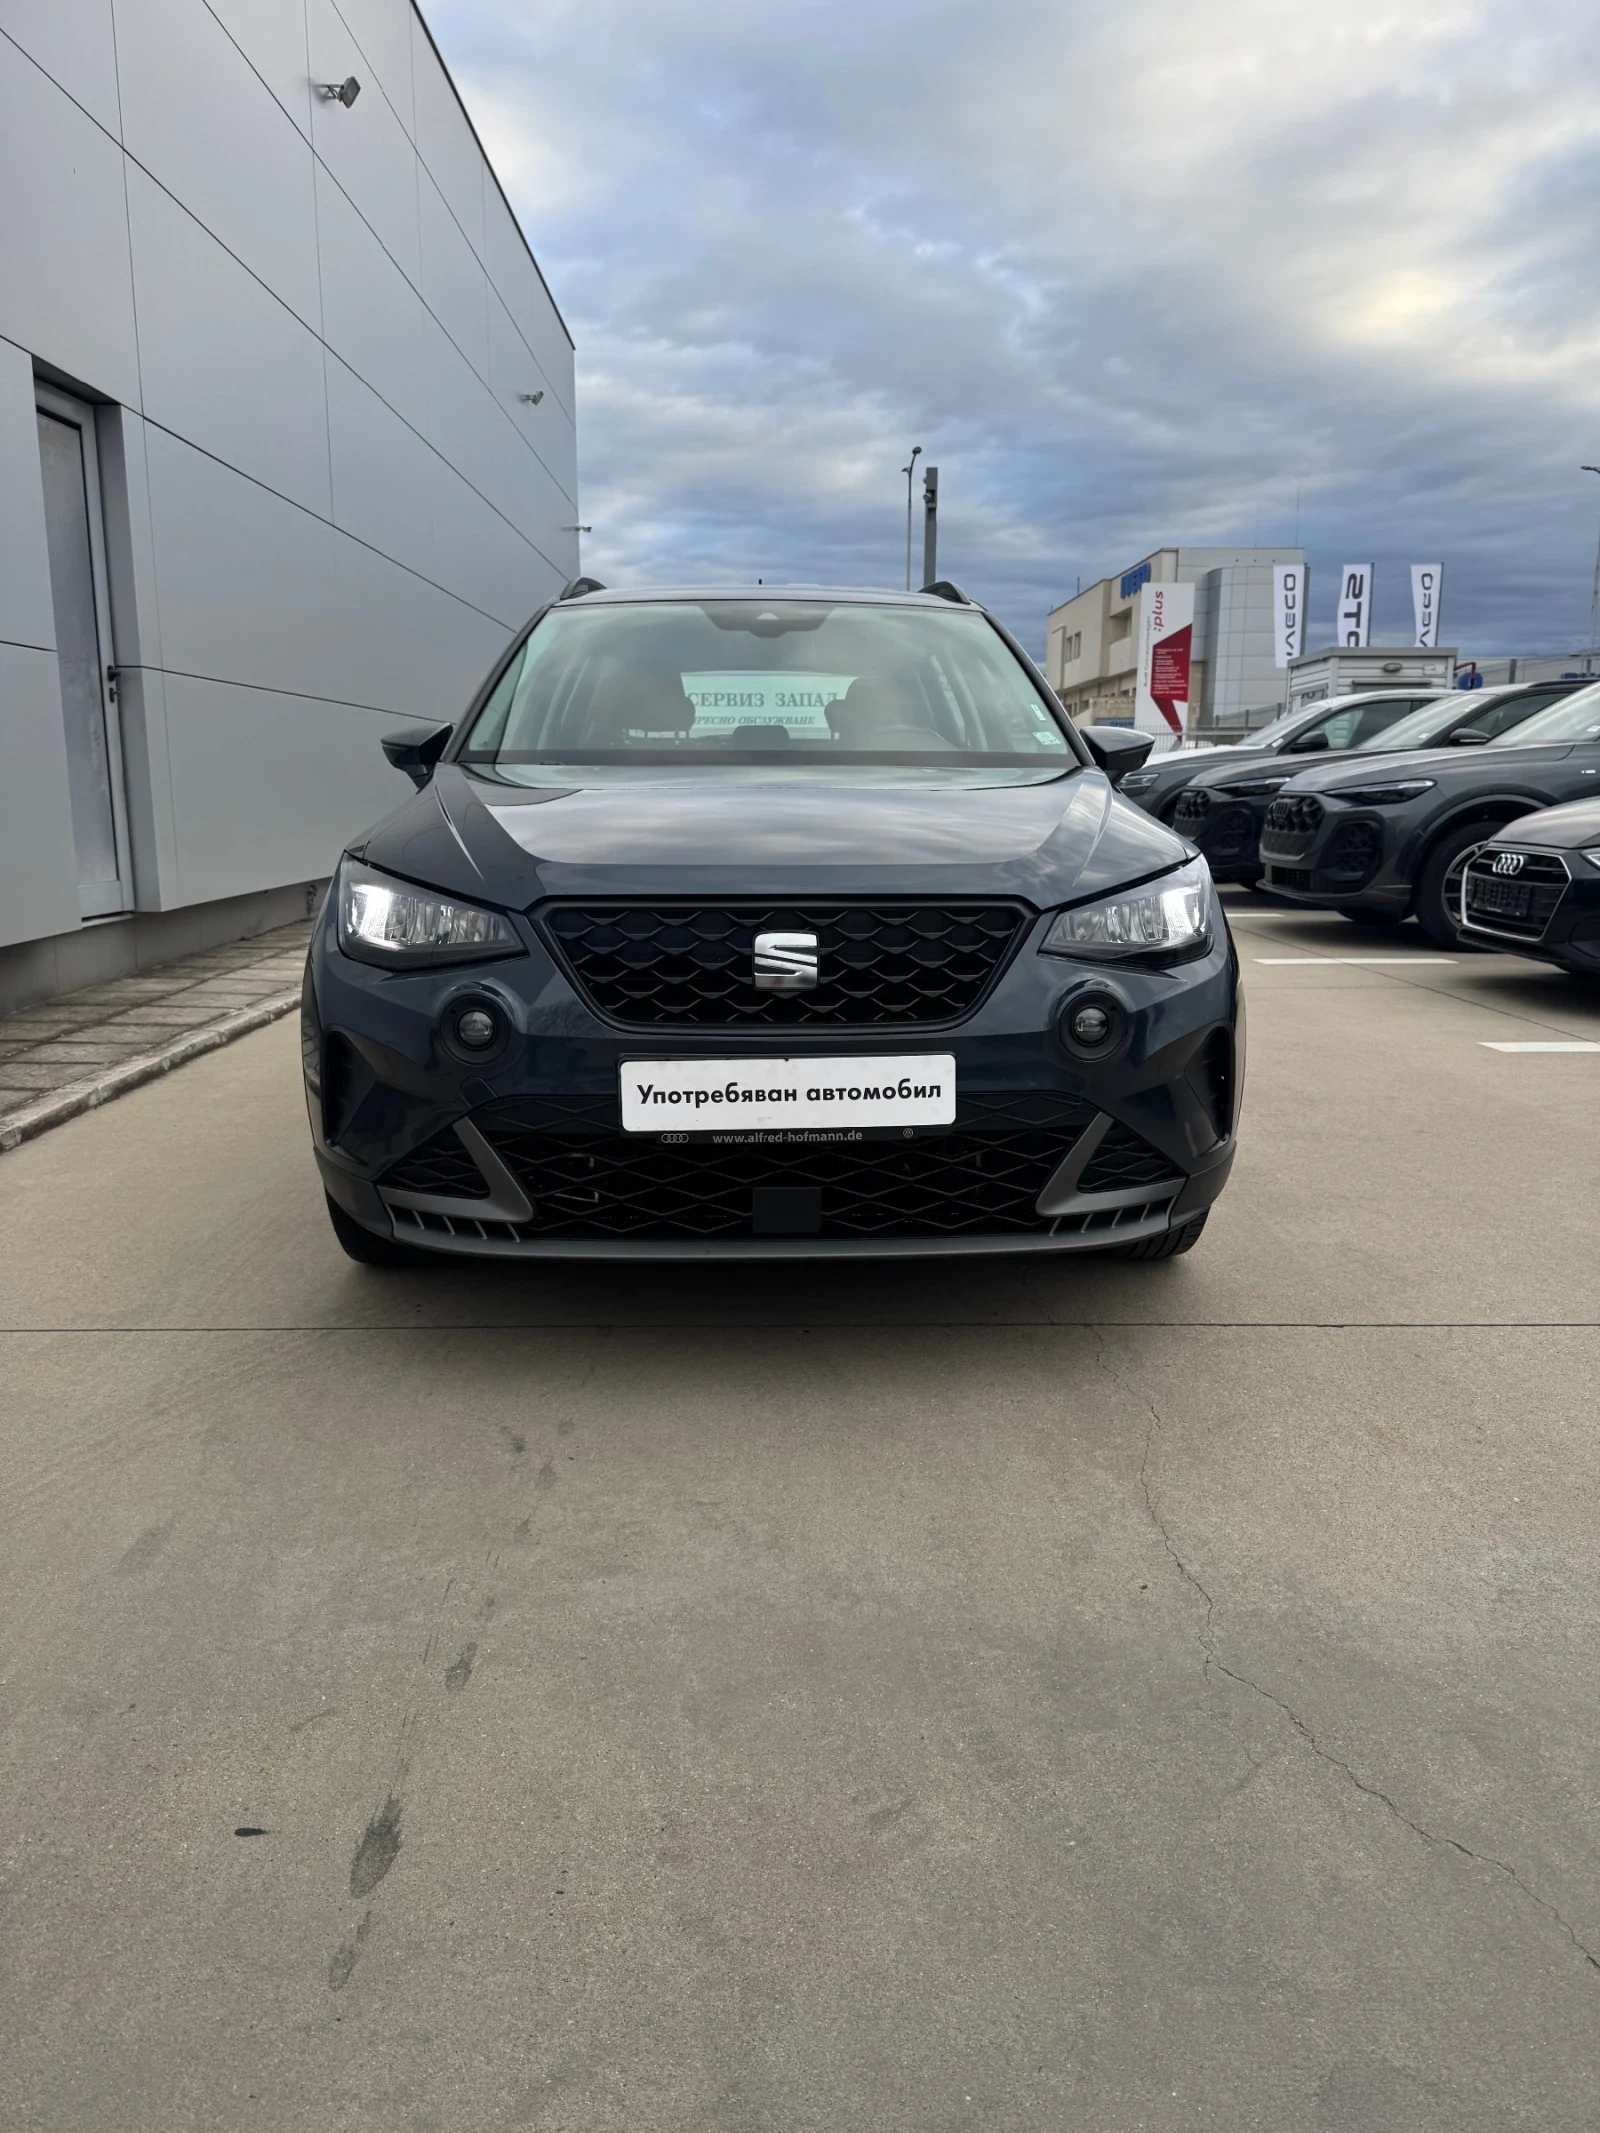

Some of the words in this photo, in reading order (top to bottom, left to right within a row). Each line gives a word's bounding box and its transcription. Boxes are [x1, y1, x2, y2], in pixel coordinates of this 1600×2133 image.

[687, 692, 765, 708] СЕРВИЗ
[636, 1081, 798, 1109] Употребяван
[806, 1077, 942, 1102] автомобил
[712, 1129, 864, 1145] www.alfred-hofmann.de
